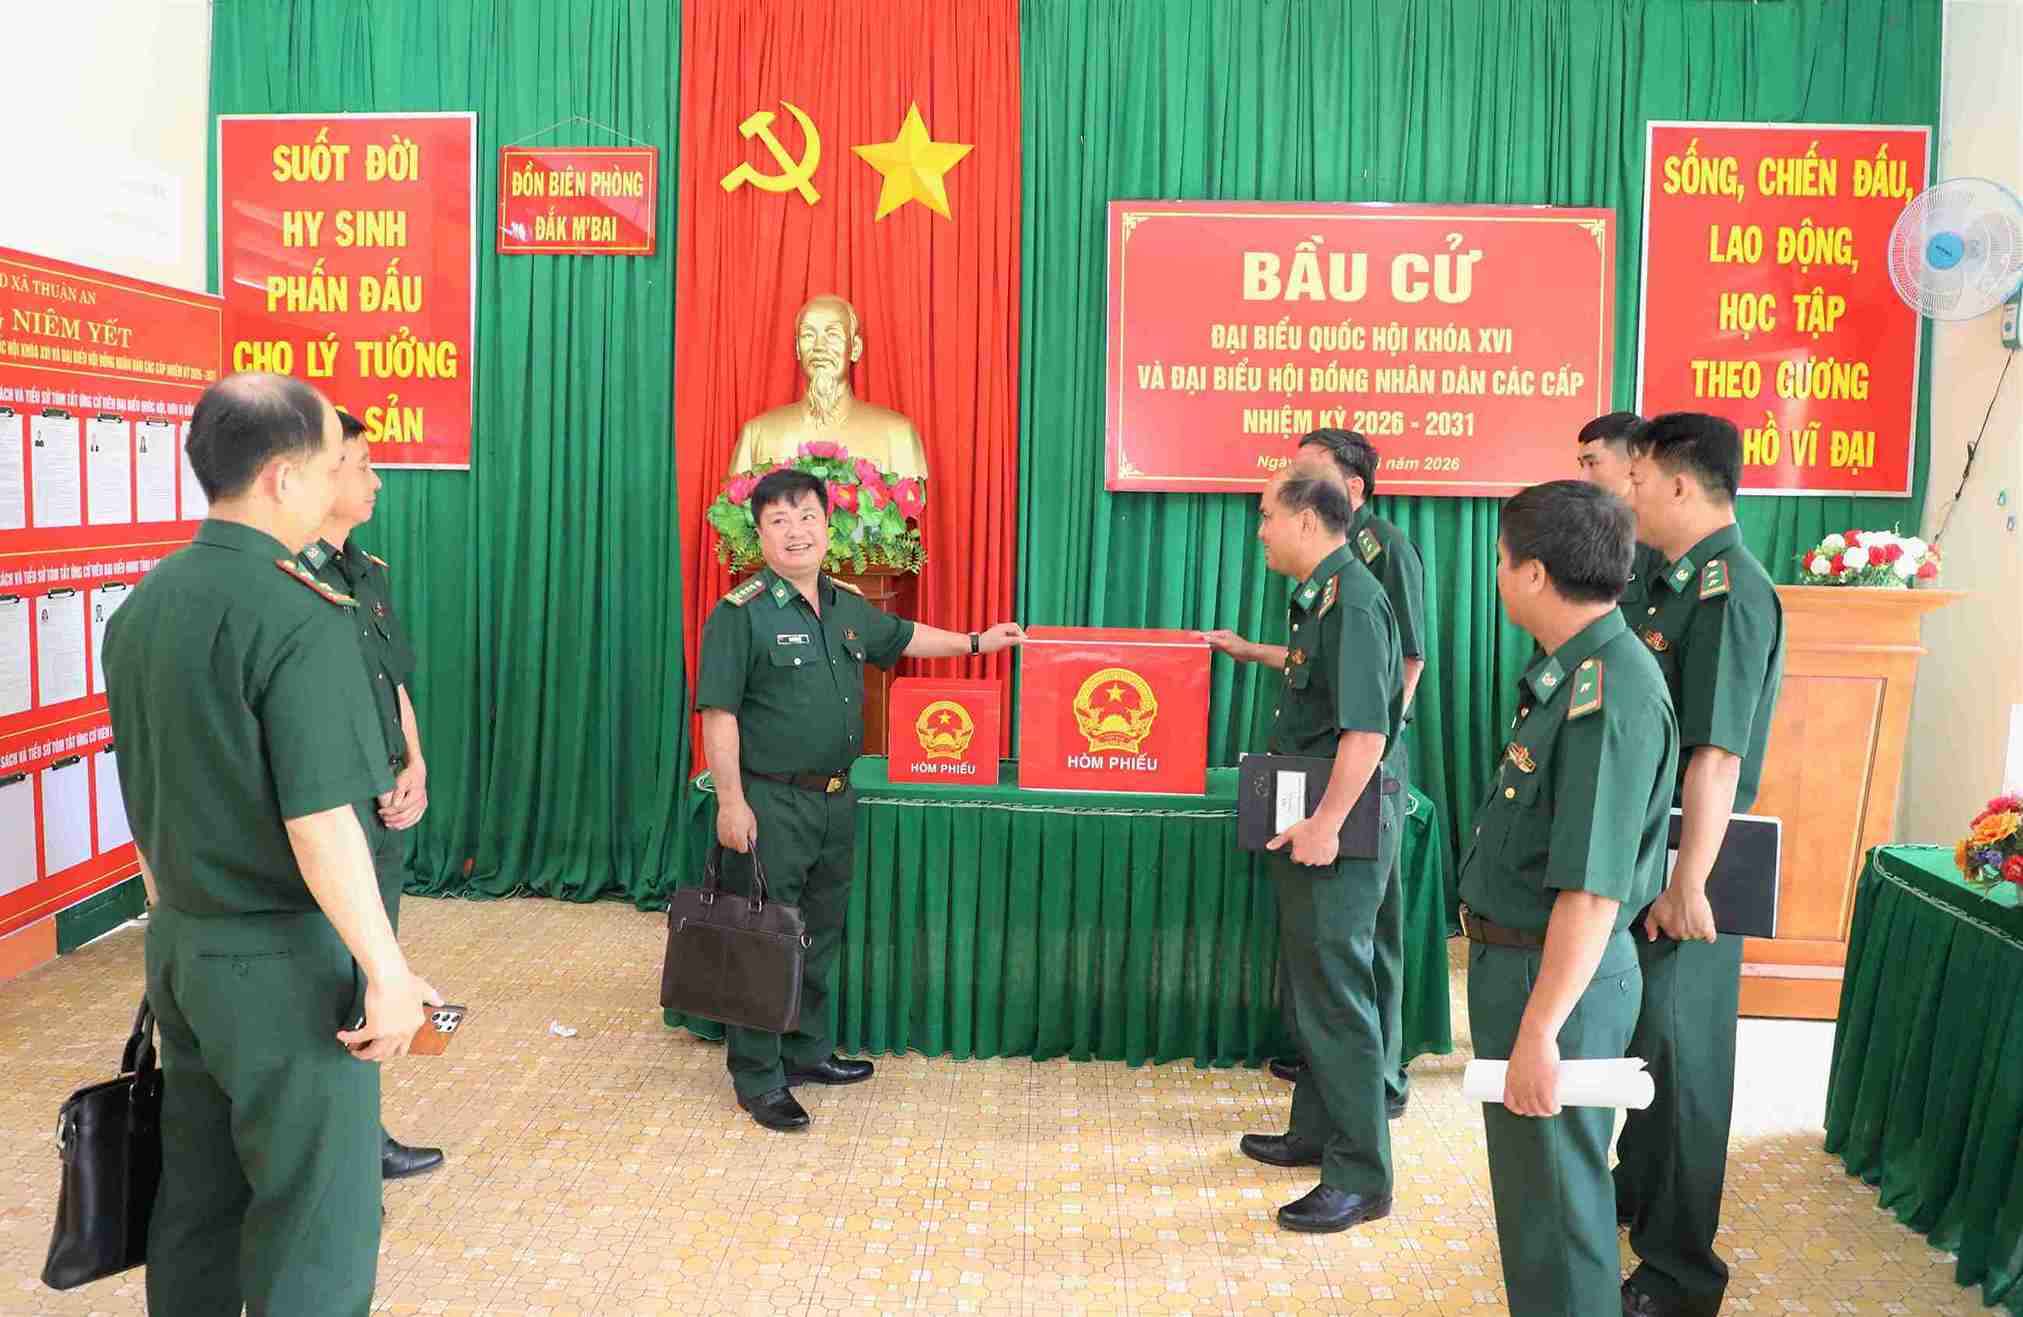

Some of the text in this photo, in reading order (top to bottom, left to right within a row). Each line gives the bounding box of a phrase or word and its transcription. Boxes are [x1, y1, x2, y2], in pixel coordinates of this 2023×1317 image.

[272, 127, 419, 183] SUỐT ĐỜI
[1663, 138, 1914, 204] SỐNG, CHIẾN ĐẤU,
[512, 160, 643, 198] ĐỒN BIÊN PHÒNG
[282, 210, 407, 247] HY SINH
[535, 206, 617, 242] ĐẮK M'BAI
[1710, 218, 1859, 273] LAO ĐỘNG,
[267, 257, 422, 313] PHẤN ĐẤU
[1243, 232, 1483, 304] BẦU CỬ
[11, 273, 30, 293] XÃ
[32, 279, 77, 303] THUẬN
[79, 288, 97, 305] AN
[11, 308, 81, 341] NIÊM
[87, 318, 133, 348] YẾT
[1720, 286, 1846, 340] HỌC TẬP
[233, 326, 457, 379] CHO LÝ TƯỞNG
[1211, 314, 1512, 355] ĐẠI BIỂU QUỐC HỘI KHÓA XVI
[1138, 357, 1584, 397] VÀ ĐẠI BIỂU HỘI ĐỒNG NHÂN DÂN CÁC CẤP
[1691, 356, 1869, 401] THEO GƯƠNG
[365, 393, 424, 443] SẢN
[1243, 405, 1312, 438] NHIỆM
[1353, 412, 1404, 436] 2026
[1425, 412, 1474, 436] 2031
[1744, 410, 1875, 475] HỒ VĨ ĐẠI
[1386, 456, 1418, 471] năm
[1424, 457, 1460, 471] 2026
[911, 760, 976, 775] HÒM PHIẾU
[1067, 752, 1158, 770] HÒM PHIẾU
